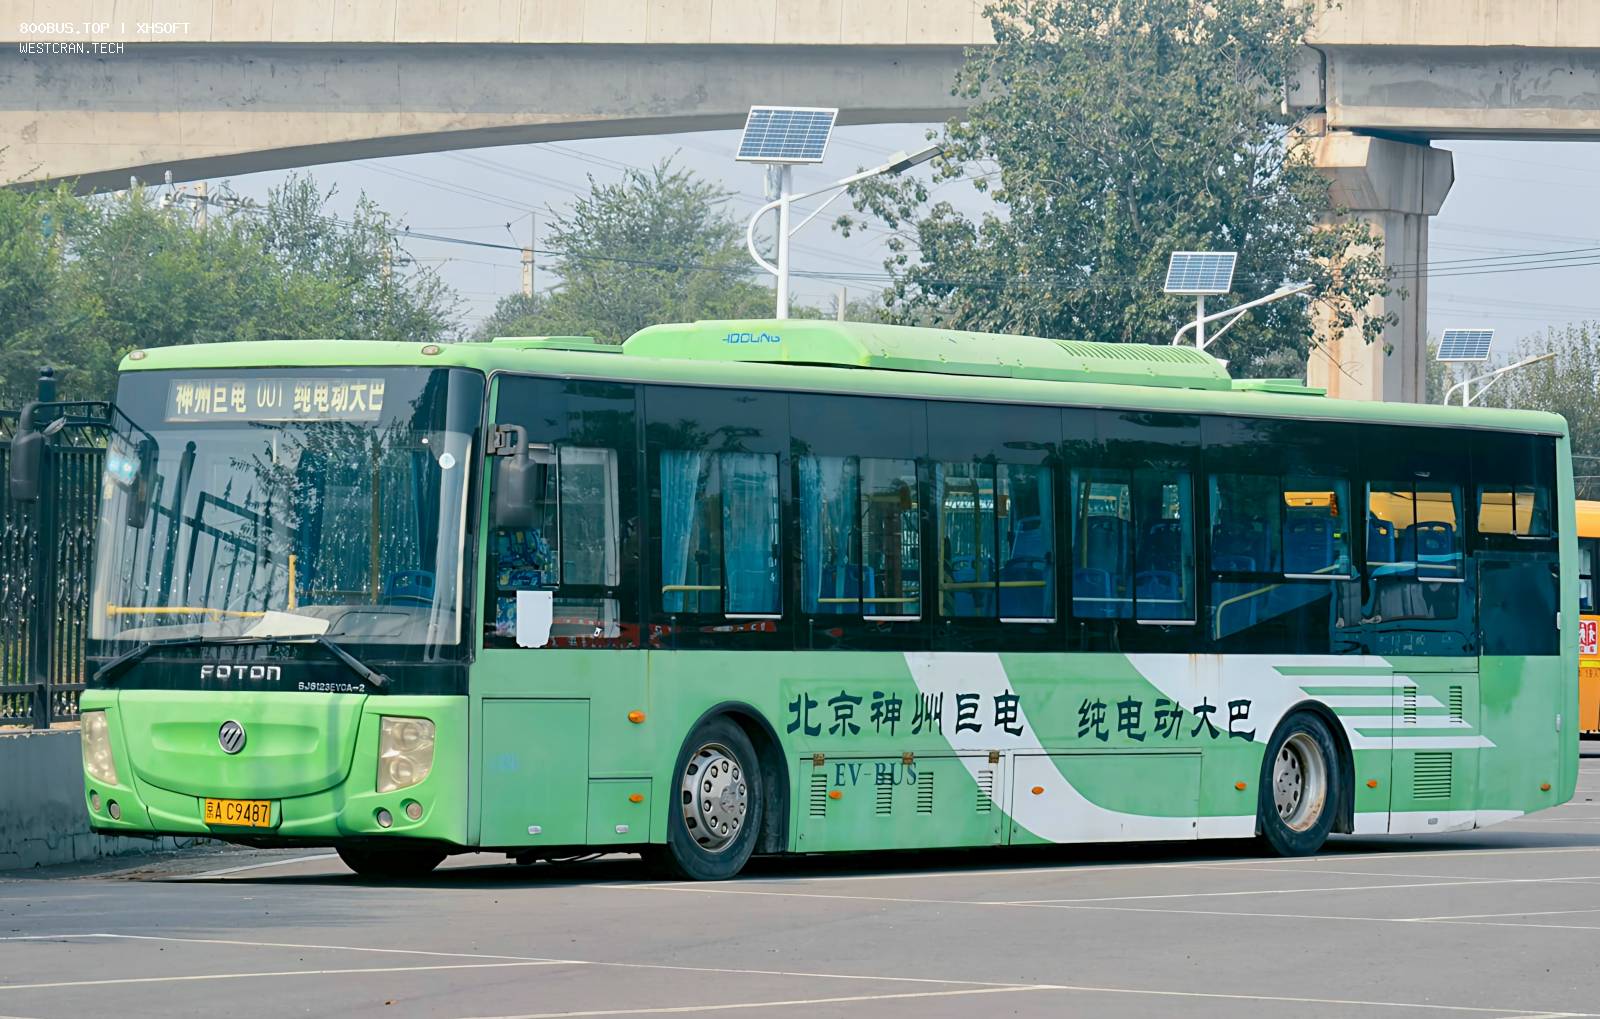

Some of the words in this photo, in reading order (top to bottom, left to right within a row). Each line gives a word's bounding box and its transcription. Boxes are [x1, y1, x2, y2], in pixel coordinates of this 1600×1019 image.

[175, 383, 247, 415] 神州巨电
[256, 382, 283, 408] 001
[293, 382, 385, 413] 纯电动大巴
[200, 664, 281, 681] FOTON
[786, 688, 1025, 737] 北京神州巨电
[1077, 694, 1257, 742] 纯电动大巴
